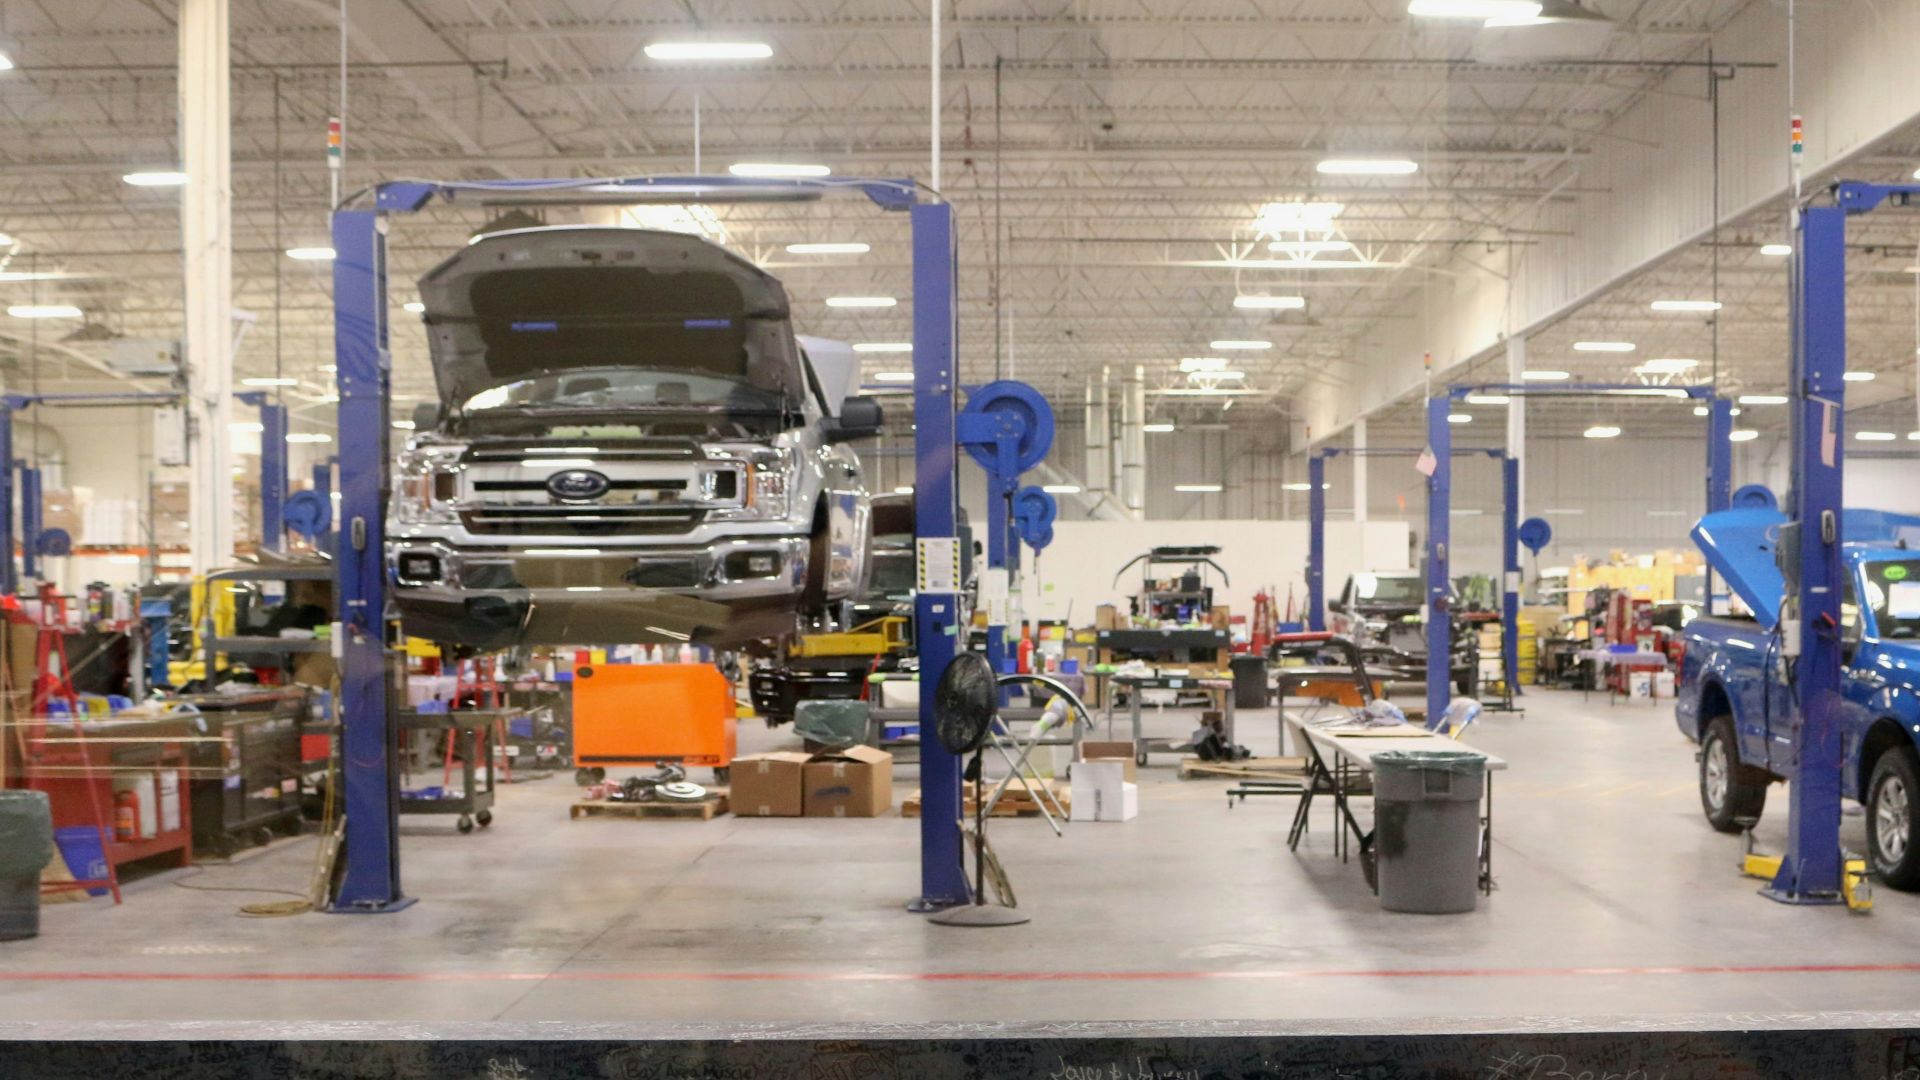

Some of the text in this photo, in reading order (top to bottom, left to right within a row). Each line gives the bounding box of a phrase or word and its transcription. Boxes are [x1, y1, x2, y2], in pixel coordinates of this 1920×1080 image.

[623, 1057, 752, 1079] Bay Area Muscle
